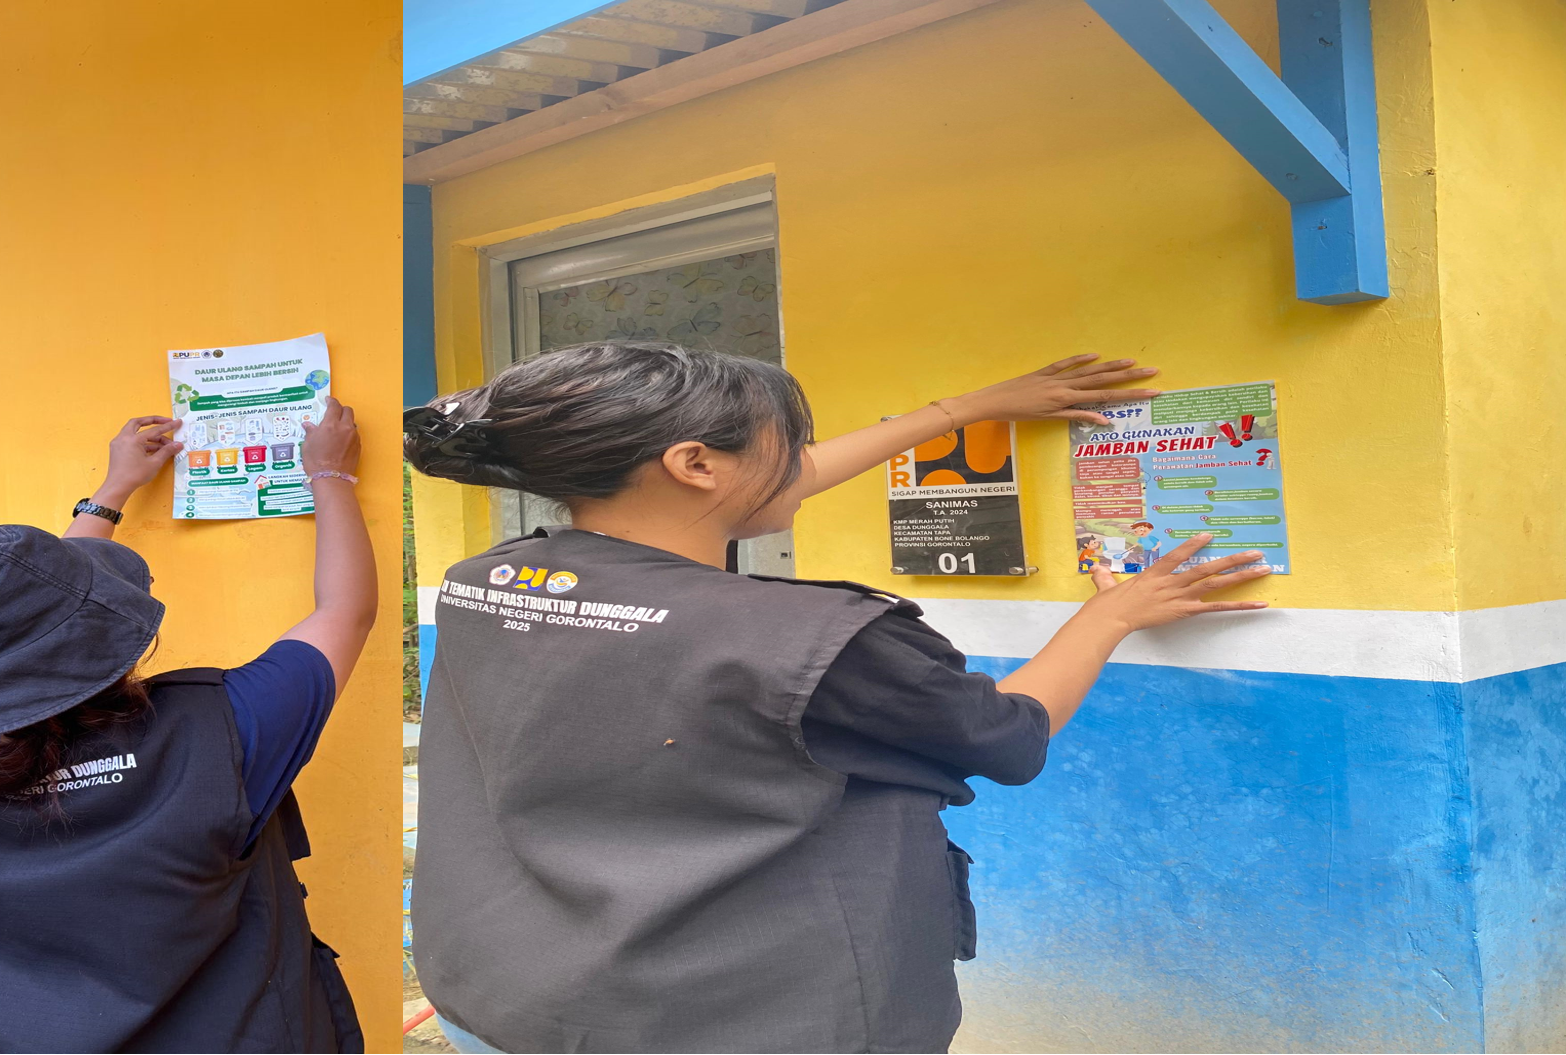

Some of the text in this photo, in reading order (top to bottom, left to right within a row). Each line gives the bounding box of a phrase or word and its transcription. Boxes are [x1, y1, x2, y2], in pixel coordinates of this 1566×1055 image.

[244, 363, 276, 371] SAMPAH
[277, 358, 303, 367] UNTUK
[273, 367, 299, 376] BERSIH
[1090, 426, 1195, 442] AYO GUNAKAN
[1074, 440, 1150, 459] JAMBAN
[1156, 435, 1217, 454] SEHAT
[1152, 455, 1197, 463] Bagaimana
[1153, 462, 1195, 471] Perawatan
[926, 500, 978, 509] SANIMAS
[938, 552, 976, 574] 01
[448, 580, 485, 600] TEMATIK
[486, 589, 578, 615] INFRASTRUKTUR
[579, 600, 669, 624] DUNGGALA
[498, 606, 544, 622] NEGERI
[545, 613, 640, 633] GORONTALO
[503, 619, 531, 632] 2025
[70, 753, 137, 778] DUNGGALA
[47, 772, 123, 793] GORONTALO
